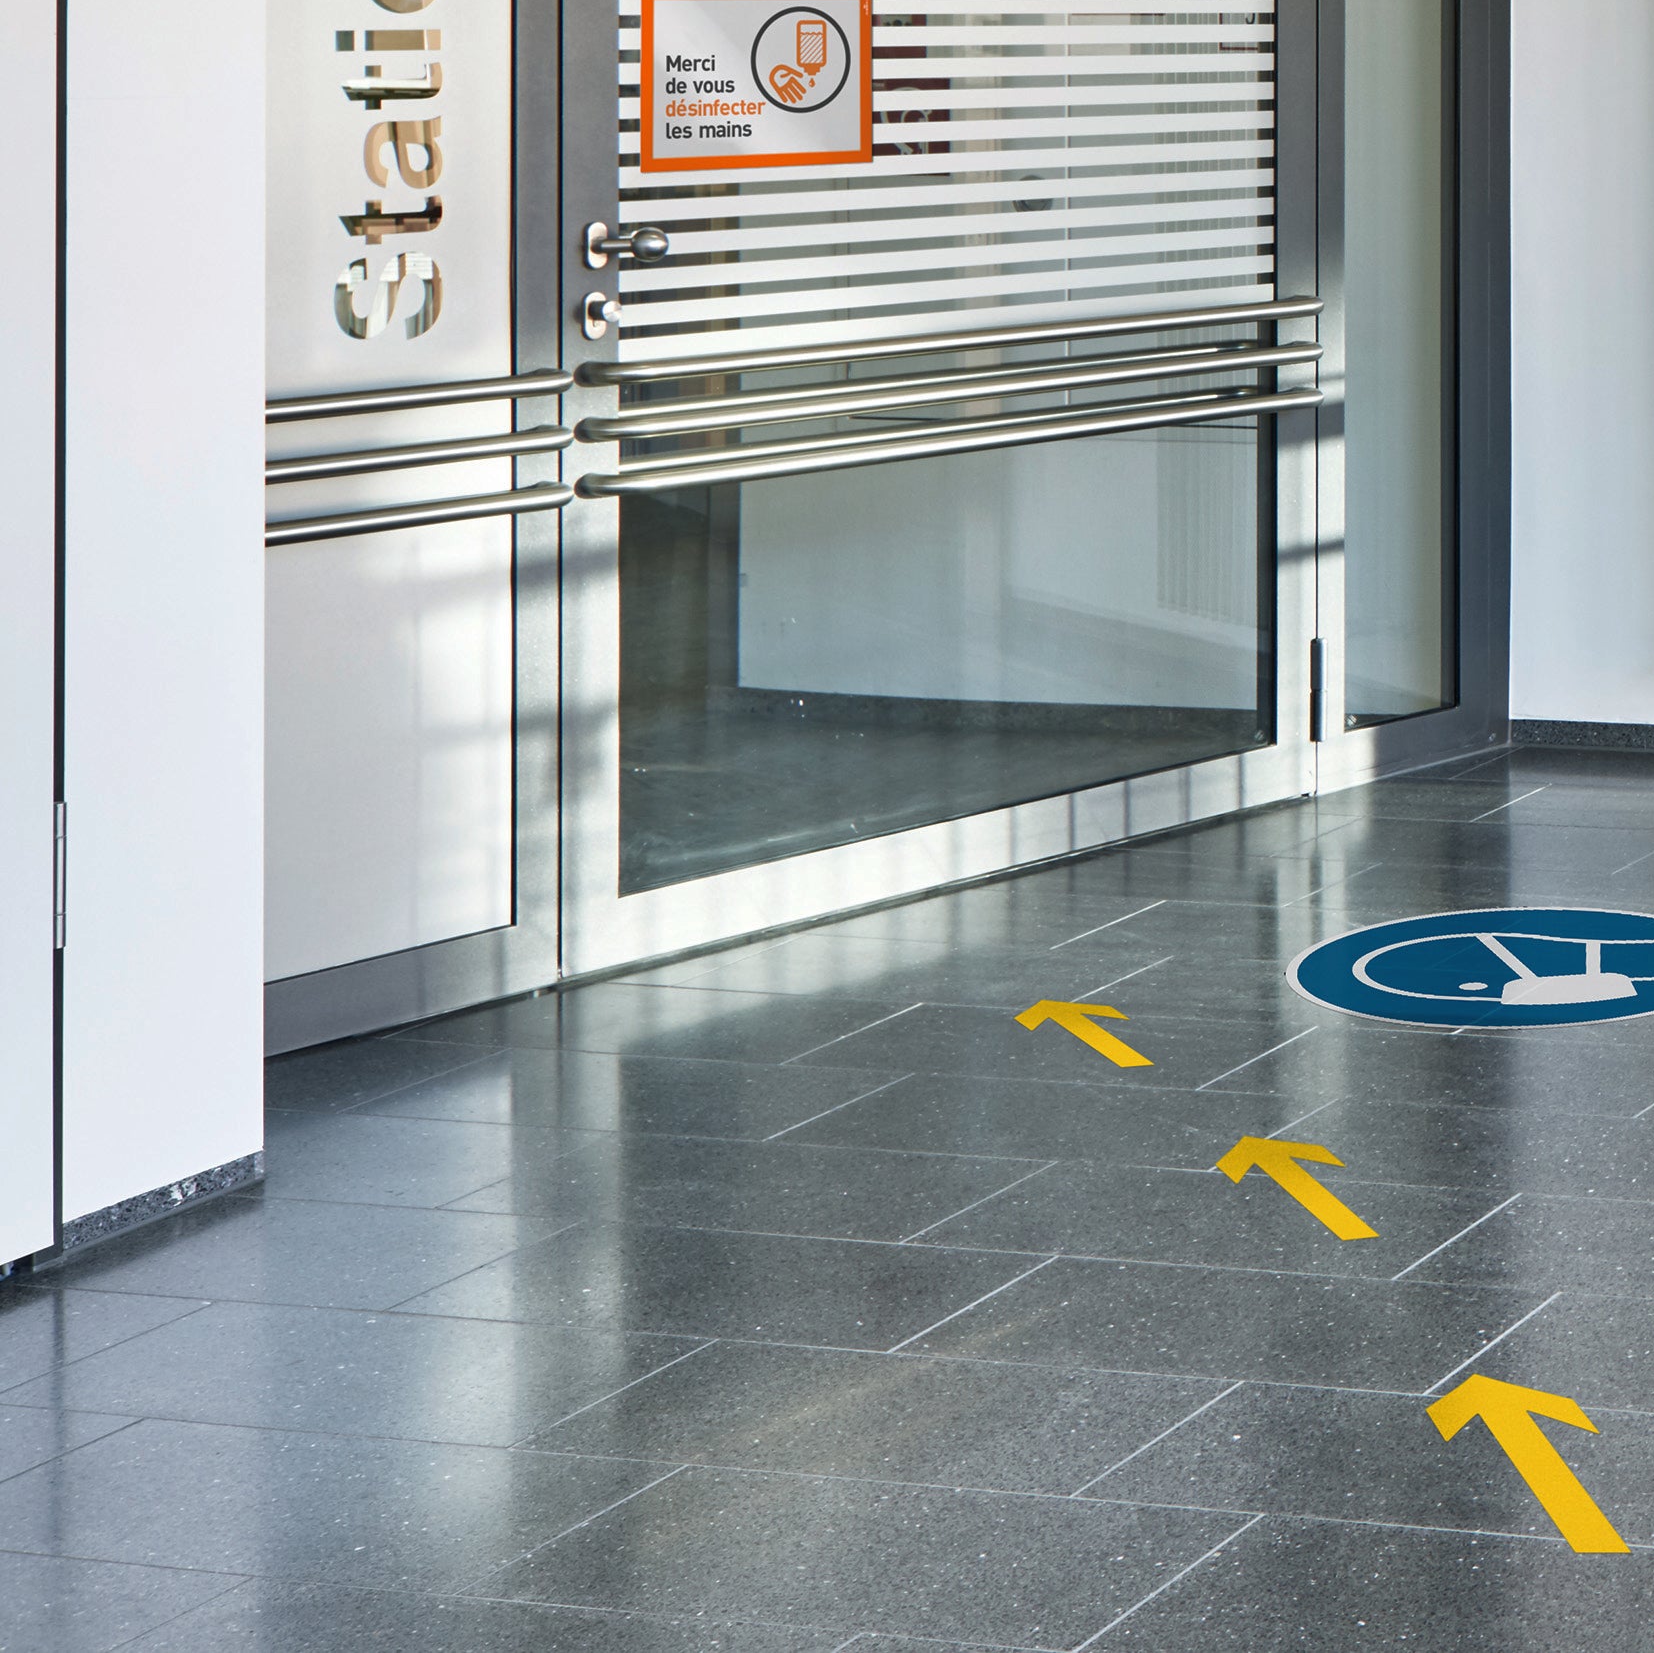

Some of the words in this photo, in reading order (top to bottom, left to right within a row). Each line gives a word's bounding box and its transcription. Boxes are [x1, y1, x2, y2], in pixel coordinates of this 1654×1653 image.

[665, 54, 716, 73] Merci
[665, 77, 688, 95] de
[692, 79, 736, 94] vous
[665, 97, 766, 118] désinfecter
[665, 120, 693, 140] les
[698, 120, 753, 139] mains
